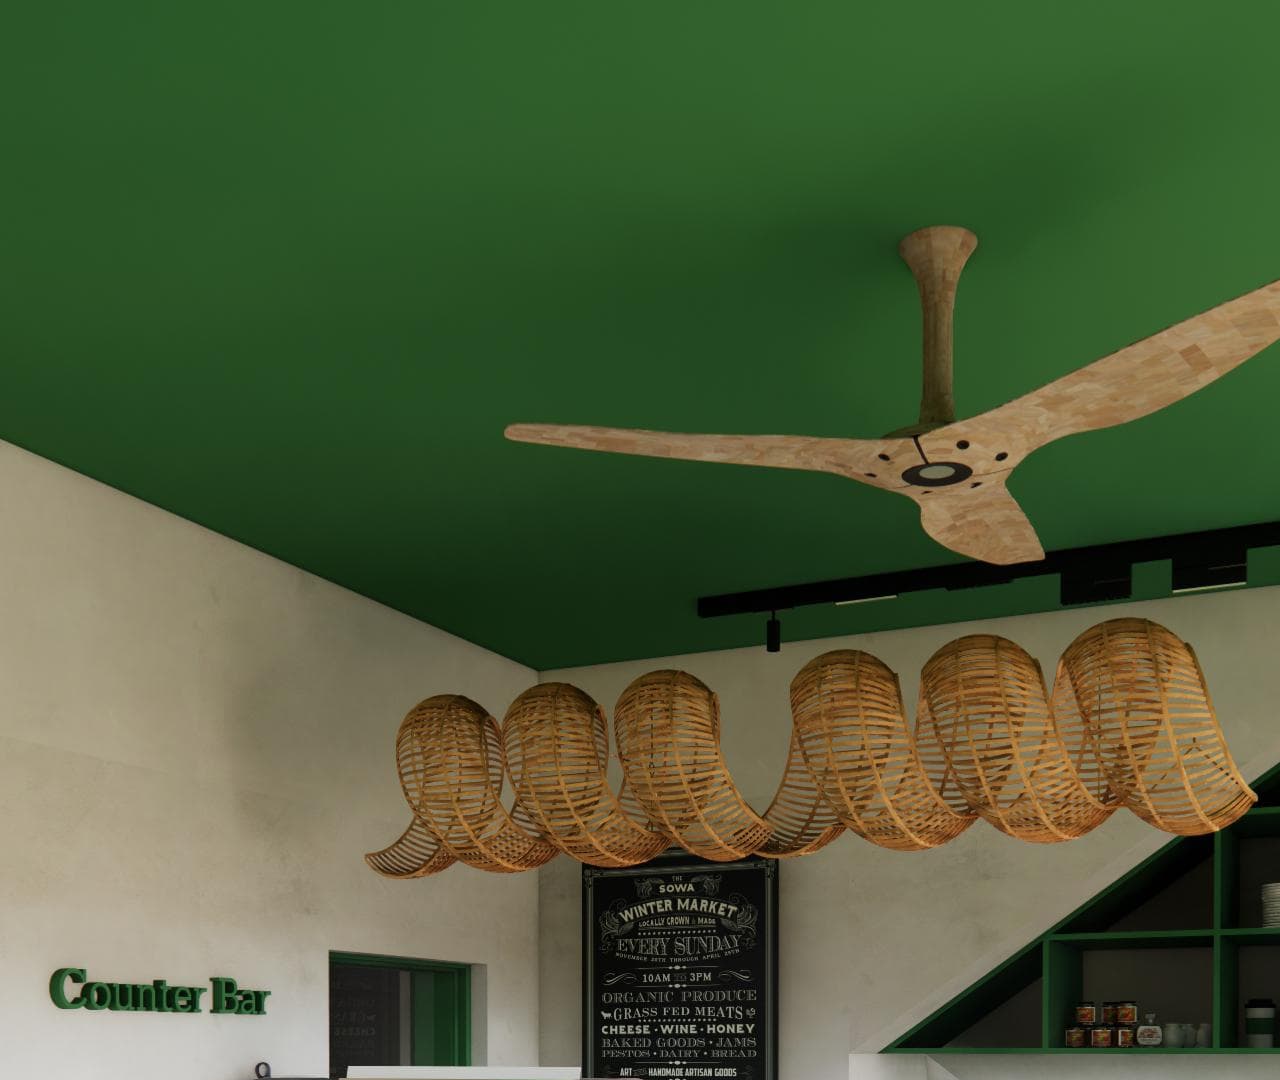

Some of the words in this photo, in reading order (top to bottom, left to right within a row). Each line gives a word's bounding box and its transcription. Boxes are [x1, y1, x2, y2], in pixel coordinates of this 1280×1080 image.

[659, 883, 695, 893] SOWA
[619, 899, 673, 923] WINTER
[677, 898, 738, 919] MARKET
[639, 918, 665, 928] LOCALLY
[617, 936, 670, 956] EVERY
[674, 934, 743, 956] SUNDAY
[642, 973, 671, 983] 10AM
[689, 972, 712, 982] 3PM
[49, 967, 207, 1013] Counter
[209, 976, 272, 1015] Bar
[601, 991, 674, 1004] ORGANIC
[681, 989, 757, 1002] PRODUCE
[613, 1007, 658, 1021] GRASS
[663, 1006, 690, 1017] FED
[695, 1006, 743, 1020] MEATS
[601, 1024, 651, 1035] CHEESE
[660, 1024, 698, 1034] WINE
[707, 1023, 756, 1034] HONEY
[601, 1038, 651, 1048] BAKED
[656, 1037, 706, 1048] GOODS
[716, 1037, 757, 1048] JAMS
[601, 1050, 651, 1058] PESTOS
[660, 1050, 700, 1058] DAIRY
[711, 1050, 757, 1058] BREAD
[620, 1068, 632, 1077] ART
[648, 1067, 684, 1077] HANDMADE
[685, 1067, 713, 1077] ARTISAN
[714, 1067, 737, 1077] GOODS
